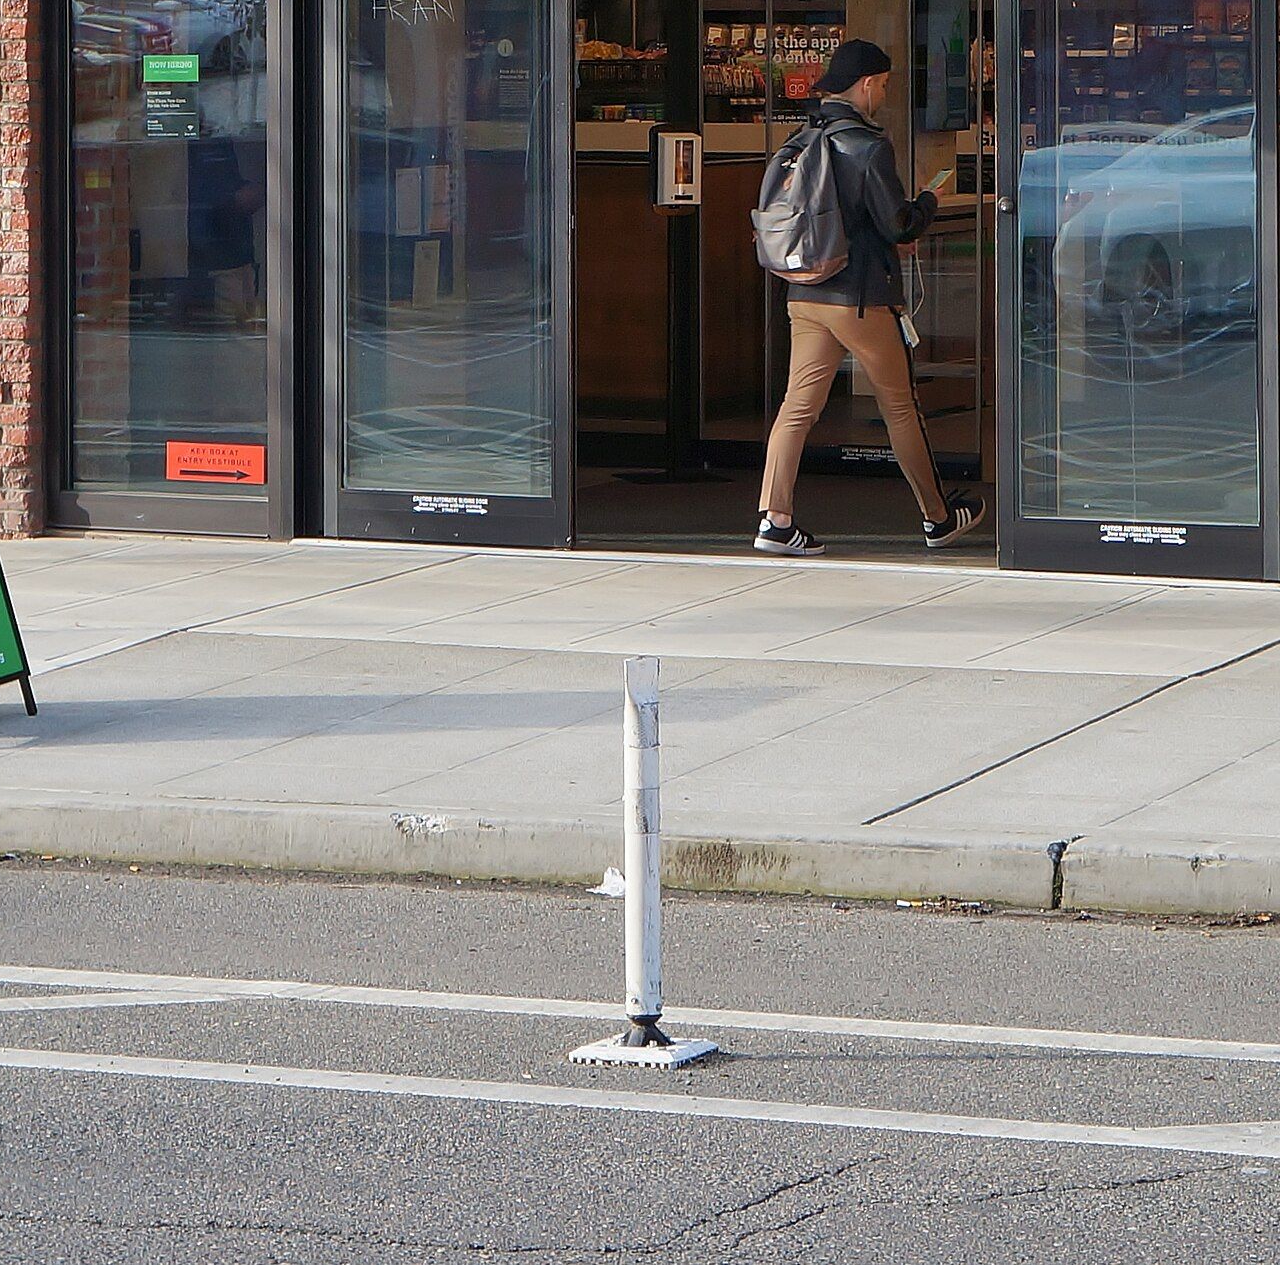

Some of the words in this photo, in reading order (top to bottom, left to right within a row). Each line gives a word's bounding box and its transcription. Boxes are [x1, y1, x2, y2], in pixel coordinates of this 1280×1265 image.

[753, 36, 781, 48] Gt
[783, 35, 807, 49] the
[811, 37, 839, 51] app
[785, 52, 826, 64] enter
[789, 84, 805, 96] go
[190, 447, 206, 455] KEY
[207, 458, 252, 467] VESTIBULE
